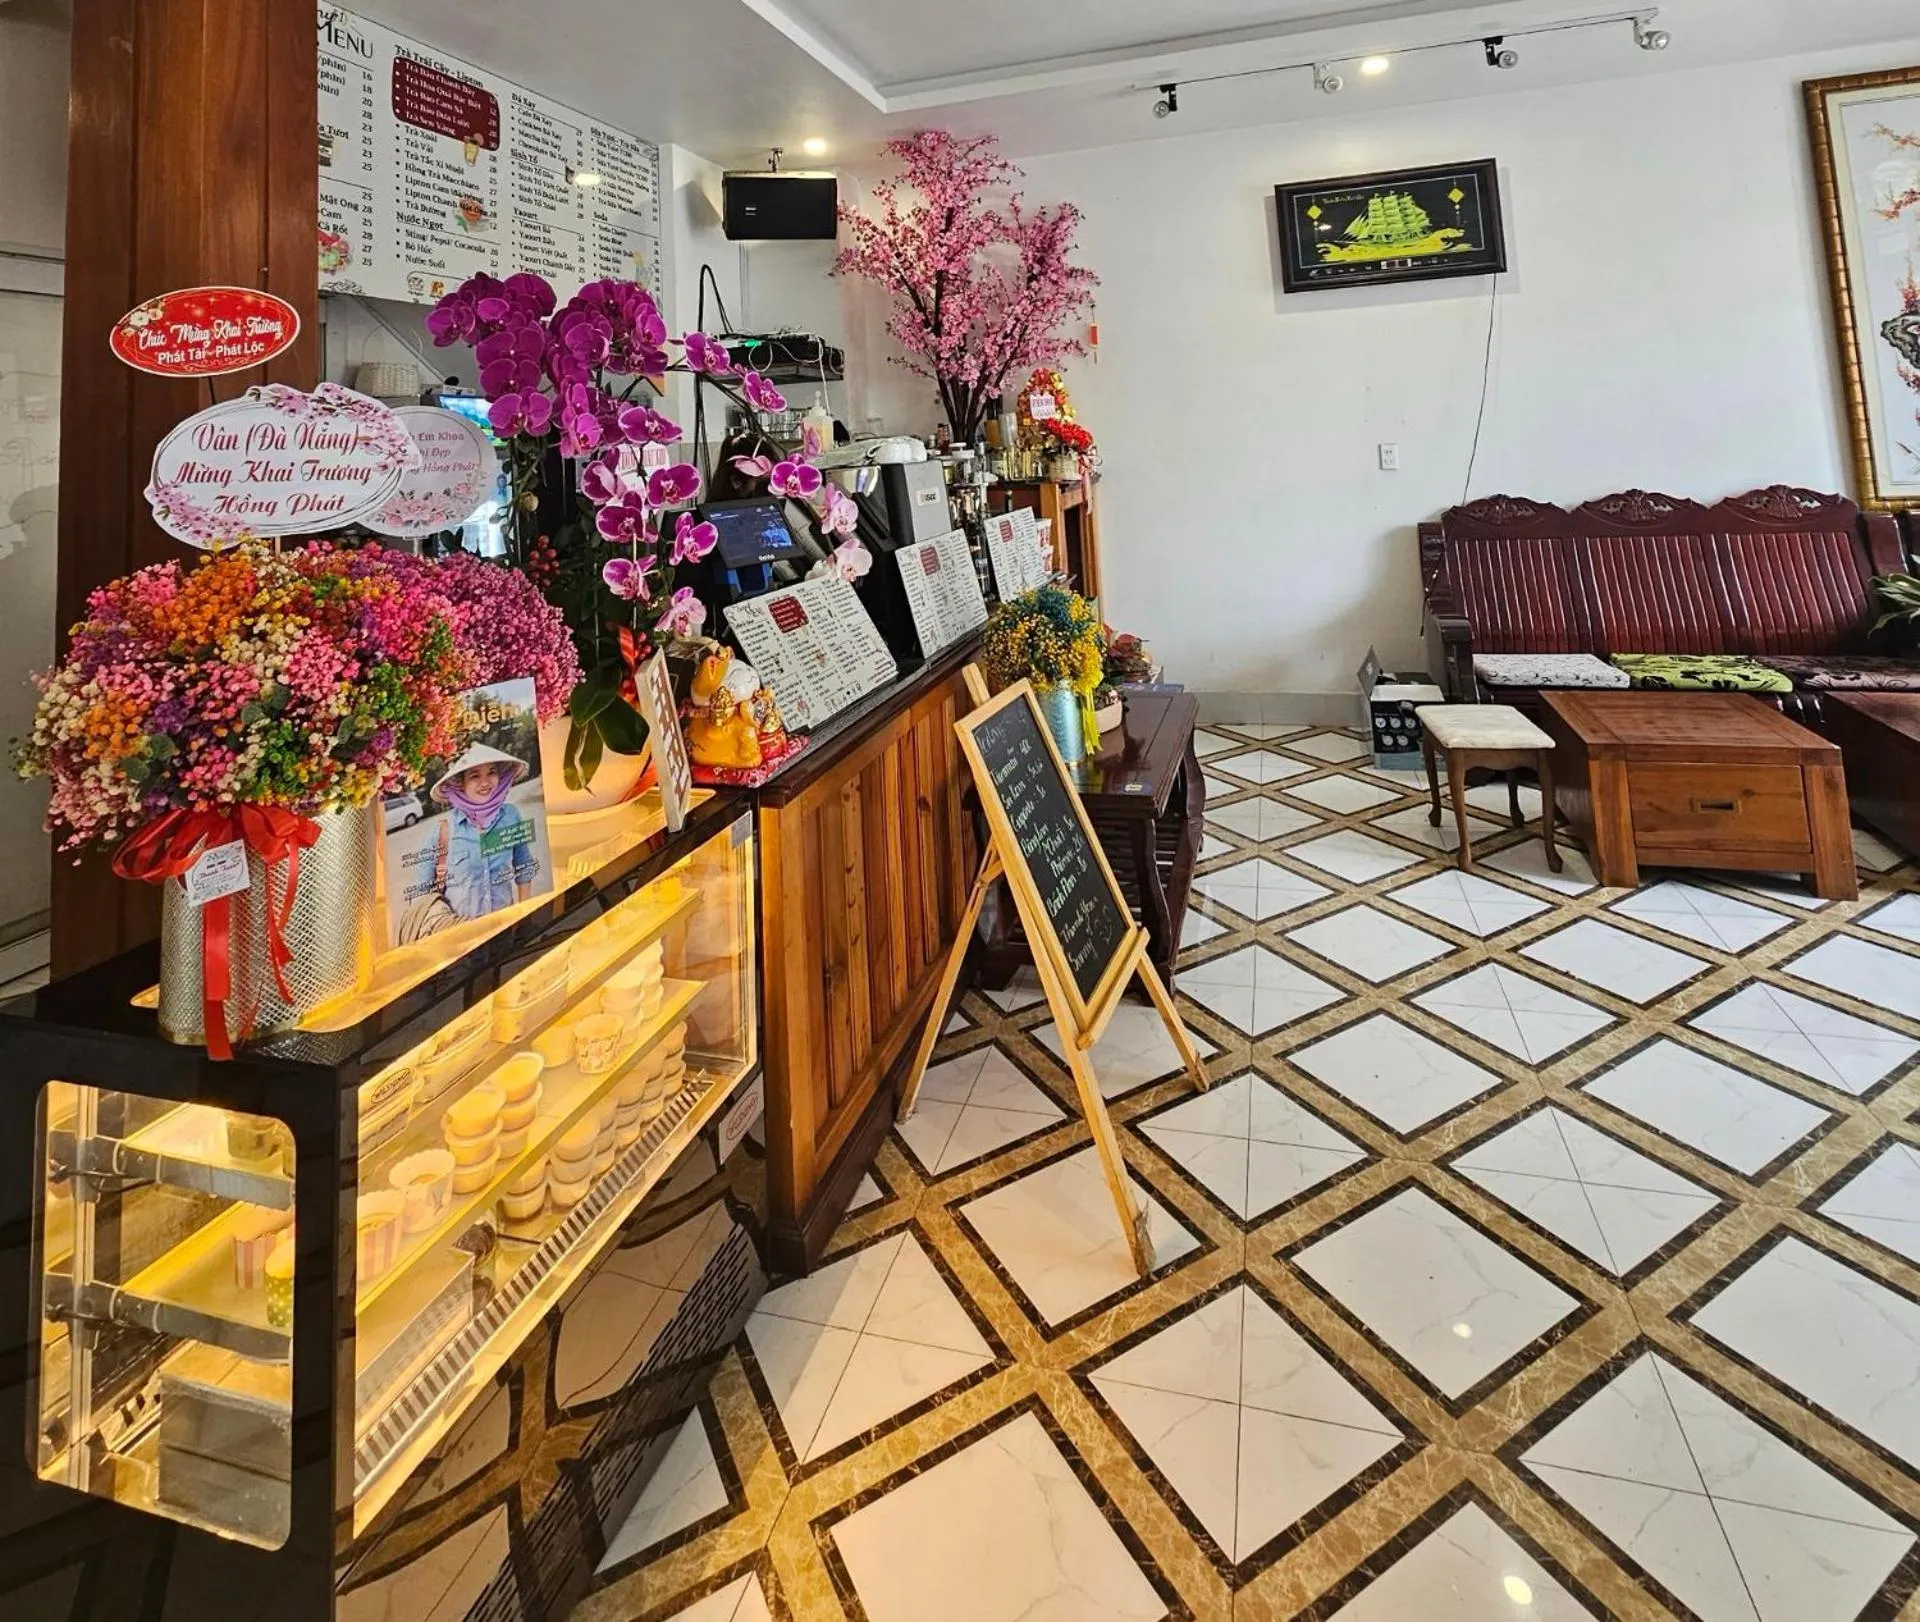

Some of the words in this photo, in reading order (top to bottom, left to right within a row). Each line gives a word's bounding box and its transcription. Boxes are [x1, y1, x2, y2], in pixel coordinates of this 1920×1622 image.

[316, 20, 373, 58] MENU
[362, 71, 372, 80] 16
[362, 84, 372, 94] 18
[362, 98, 372, 107] 20
[405, 126, 418, 137] Trà
[405, 137, 419, 149] Trà
[405, 150, 419, 161] Trà
[362, 163, 372, 171] 25
[405, 176, 430, 190] Lipton
[362, 192, 372, 200] 25
[405, 188, 430, 203] Lipton
[340, 197, 359, 211] Ong
[405, 200, 419, 211] Trà
[321, 208, 342, 220] Cam
[362, 219, 372, 227] 25
[362, 258, 372, 266] 25
[139, 328, 167, 350] Chúc
[213, 320, 242, 339] Khai
[158, 352, 185, 364] Phát
[189, 349, 205, 360] Tài
[215, 344, 241, 357] Phát
[243, 341, 265, 356] Lộc
[192, 423, 238, 451] Vân
[247, 422, 285, 456] (Đà
[174, 462, 232, 487] Mừng
[240, 460, 294, 484] Khai
[301, 460, 372, 485] Trương
[214, 493, 278, 516] Hồng
[286, 493, 345, 515] Phát
